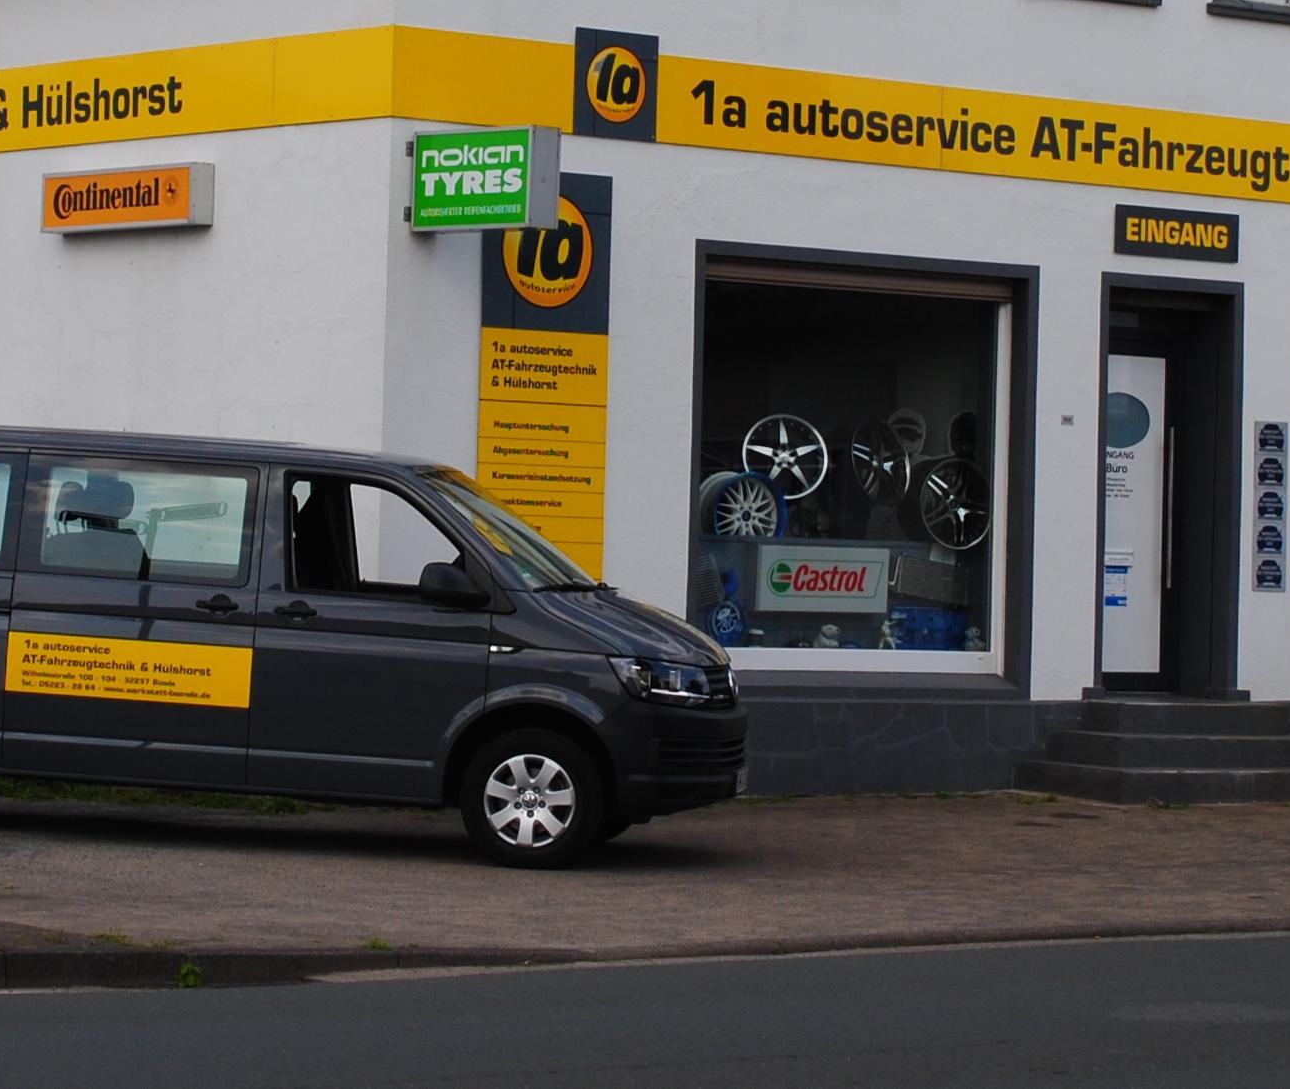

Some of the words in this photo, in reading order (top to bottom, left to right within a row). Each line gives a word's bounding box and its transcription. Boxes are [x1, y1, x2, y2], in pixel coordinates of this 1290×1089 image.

[22, 76, 184, 129] Hülshorst
[691, 79, 747, 129] 1a
[765, 99, 1016, 156] autoservice
[420, 168, 523, 197] TYRES
[52, 177, 160, 220] Continental
[1125, 216, 1229, 250] EINGANG
[519, 279, 576, 294] autoservice
[492, 340, 506, 353] 1a
[510, 344, 573, 357] autoservice
[491, 359, 597, 377] AT-Fahrzeugtechnik
[491, 375, 500, 387] &
[504, 376, 558, 391] Hülshorst
[792, 563, 868, 593] Castrol
[24, 639, 39, 650] 1a
[42, 640, 111, 655] autoservice
[22, 654, 136, 672] AT-Fahrzeugtechnik
[140, 661, 149, 672] &
